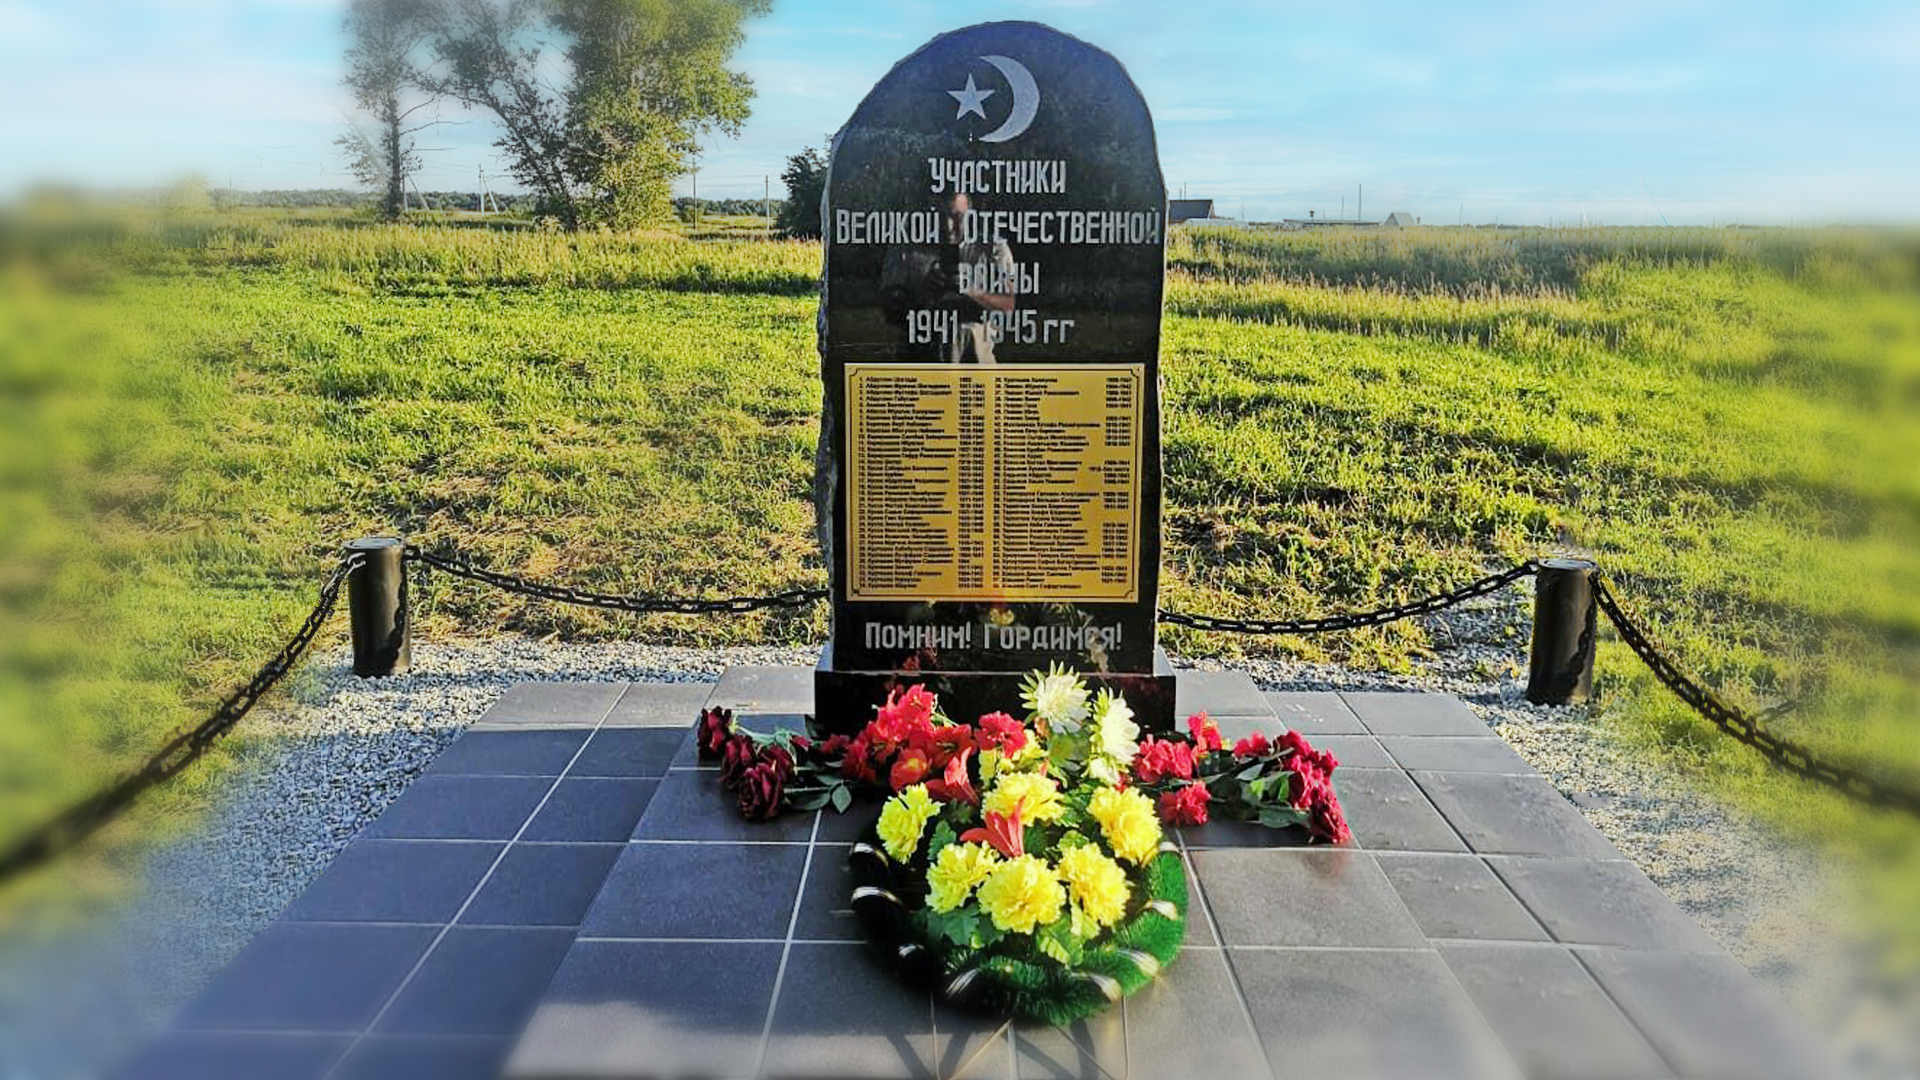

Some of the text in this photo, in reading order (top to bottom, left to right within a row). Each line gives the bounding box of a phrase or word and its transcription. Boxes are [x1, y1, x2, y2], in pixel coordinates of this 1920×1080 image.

[928, 157, 1066, 193] УЧАСТНИКИ
[836, 206, 1160, 244] ВЕЛИКОЙ ОТЕЧЕСТВЕННОЙ
[865, 621, 971, 649] ПОМНИМ!
